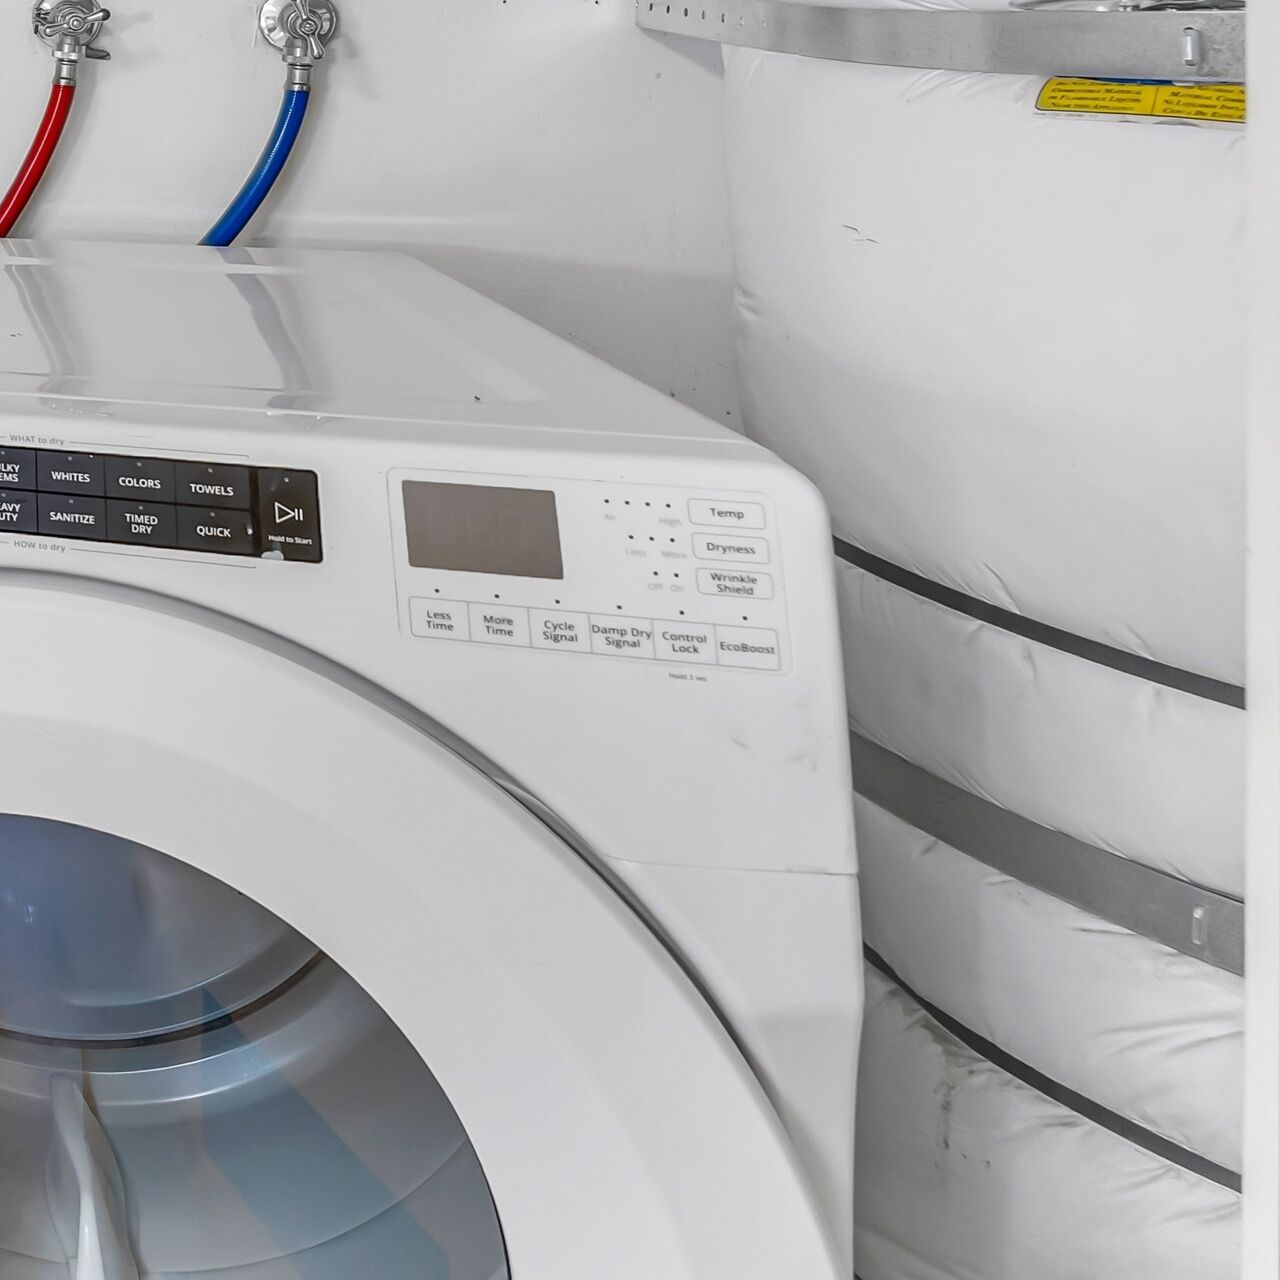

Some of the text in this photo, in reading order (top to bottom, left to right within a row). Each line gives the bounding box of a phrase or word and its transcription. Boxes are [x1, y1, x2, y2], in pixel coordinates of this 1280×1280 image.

[10, 434, 35, 443] WHAT
[49, 437, 65, 447] dry
[51, 471, 91, 483] WHITES
[119, 477, 161, 489] COLORS
[190, 483, 234, 497] TOWELS
[49, 511, 96, 525] SANITIZE
[125, 513, 158, 525] TIMED
[709, 507, 745, 520] Temp
[131, 523, 153, 535] DRY
[196, 525, 232, 538] QUICK
[268, 534, 284, 542] Hold
[294, 537, 313, 545] Start
[14, 540, 66, 553] HOW to dry
[706, 542, 756, 555] Dryness
[710, 572, 758, 585] Wrinkle
[716, 583, 754, 596] Shield
[426, 610, 452, 621] Less
[483, 615, 514, 626] More
[426, 620, 454, 632] Time
[485, 626, 514, 637] Time
[544, 620, 575, 632] Cycle
[592, 624, 652, 640] Damp Dry
[542, 631, 578, 643] Signal
[662, 631, 707, 643] Control
[605, 637, 641, 650] Signal
[671, 643, 700, 654] Lock
[719, 642, 776, 655] EcoBoost
